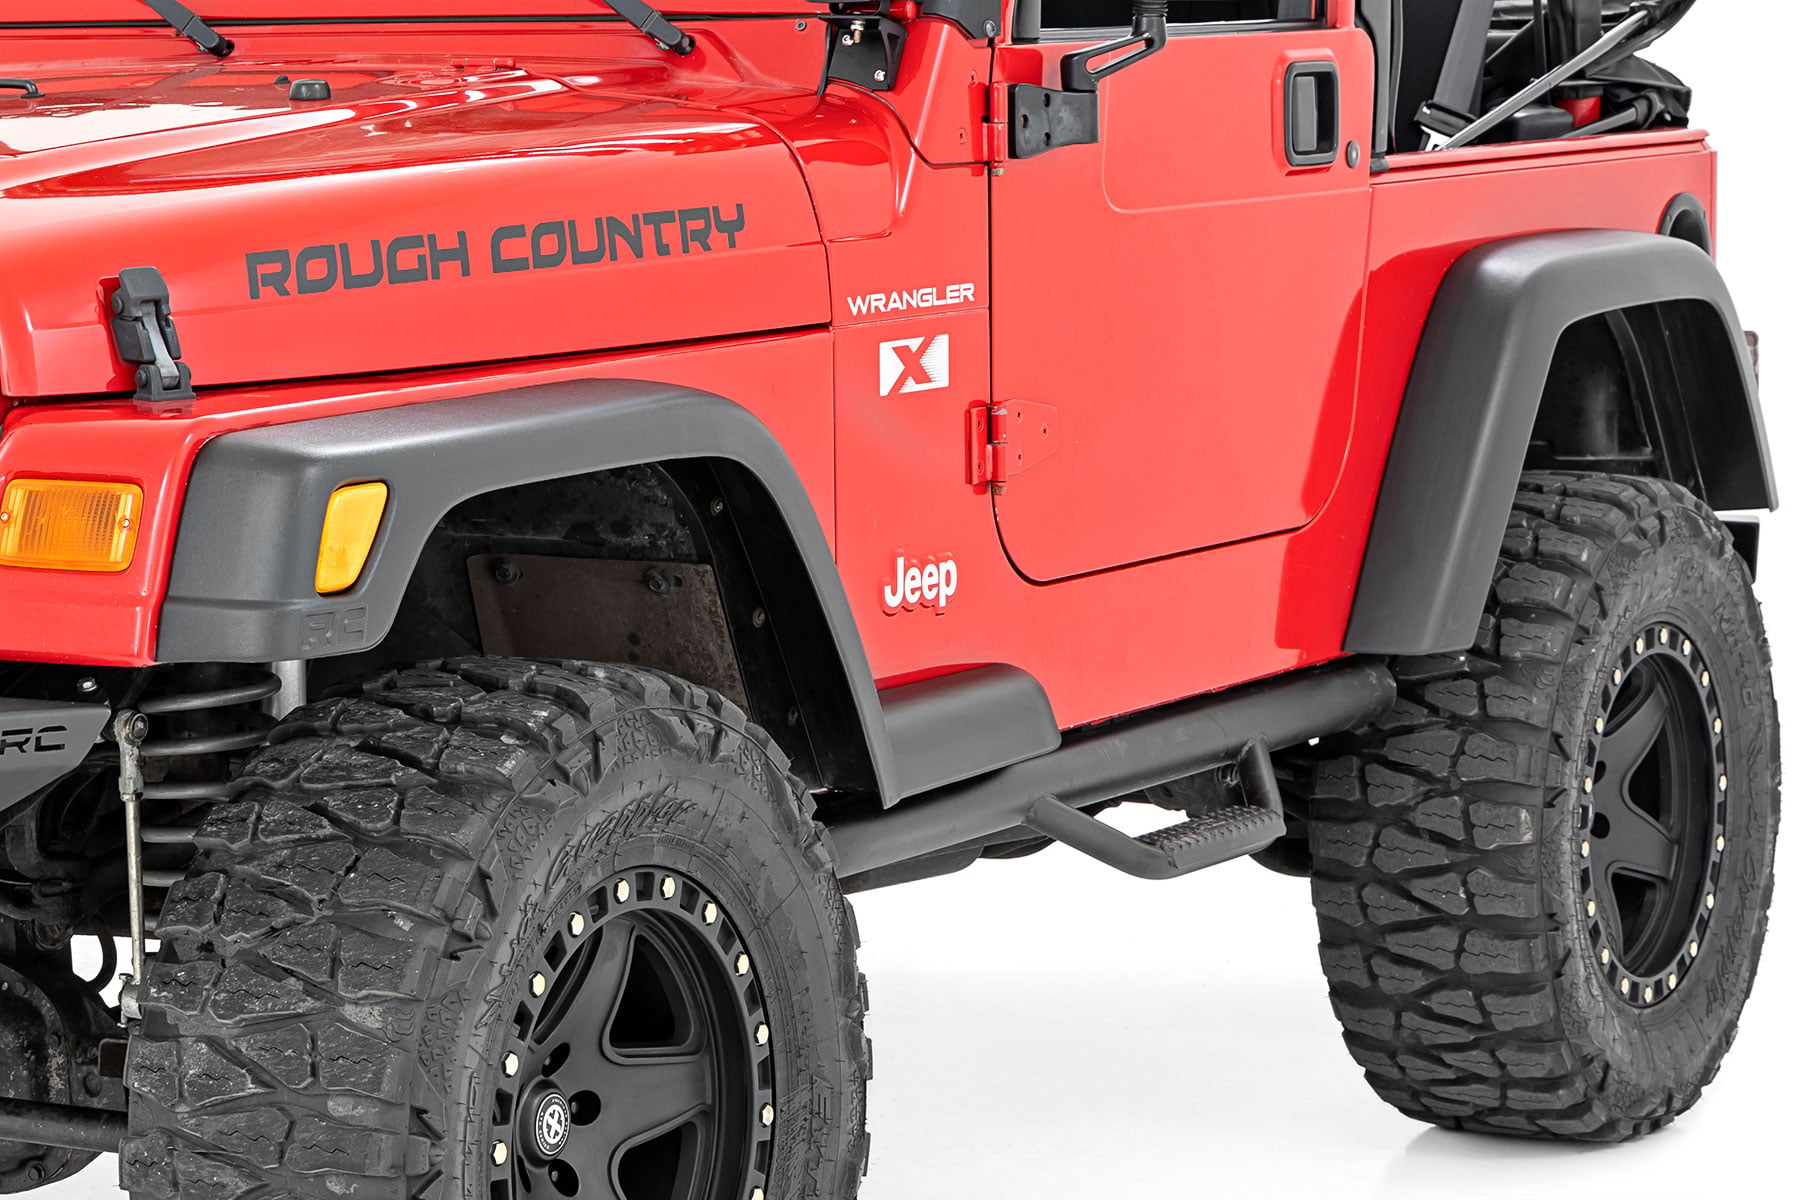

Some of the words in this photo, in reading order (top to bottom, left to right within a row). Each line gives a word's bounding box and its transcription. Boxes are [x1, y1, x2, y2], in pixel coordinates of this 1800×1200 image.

[246, 230, 471, 300] ROUGH
[490, 203, 746, 274] COUNTRY
[847, 283, 975, 316] WRANGLER
[884, 335, 942, 396] X
[884, 556, 958, 608] Jeep
[0, 725, 68, 756] RC
